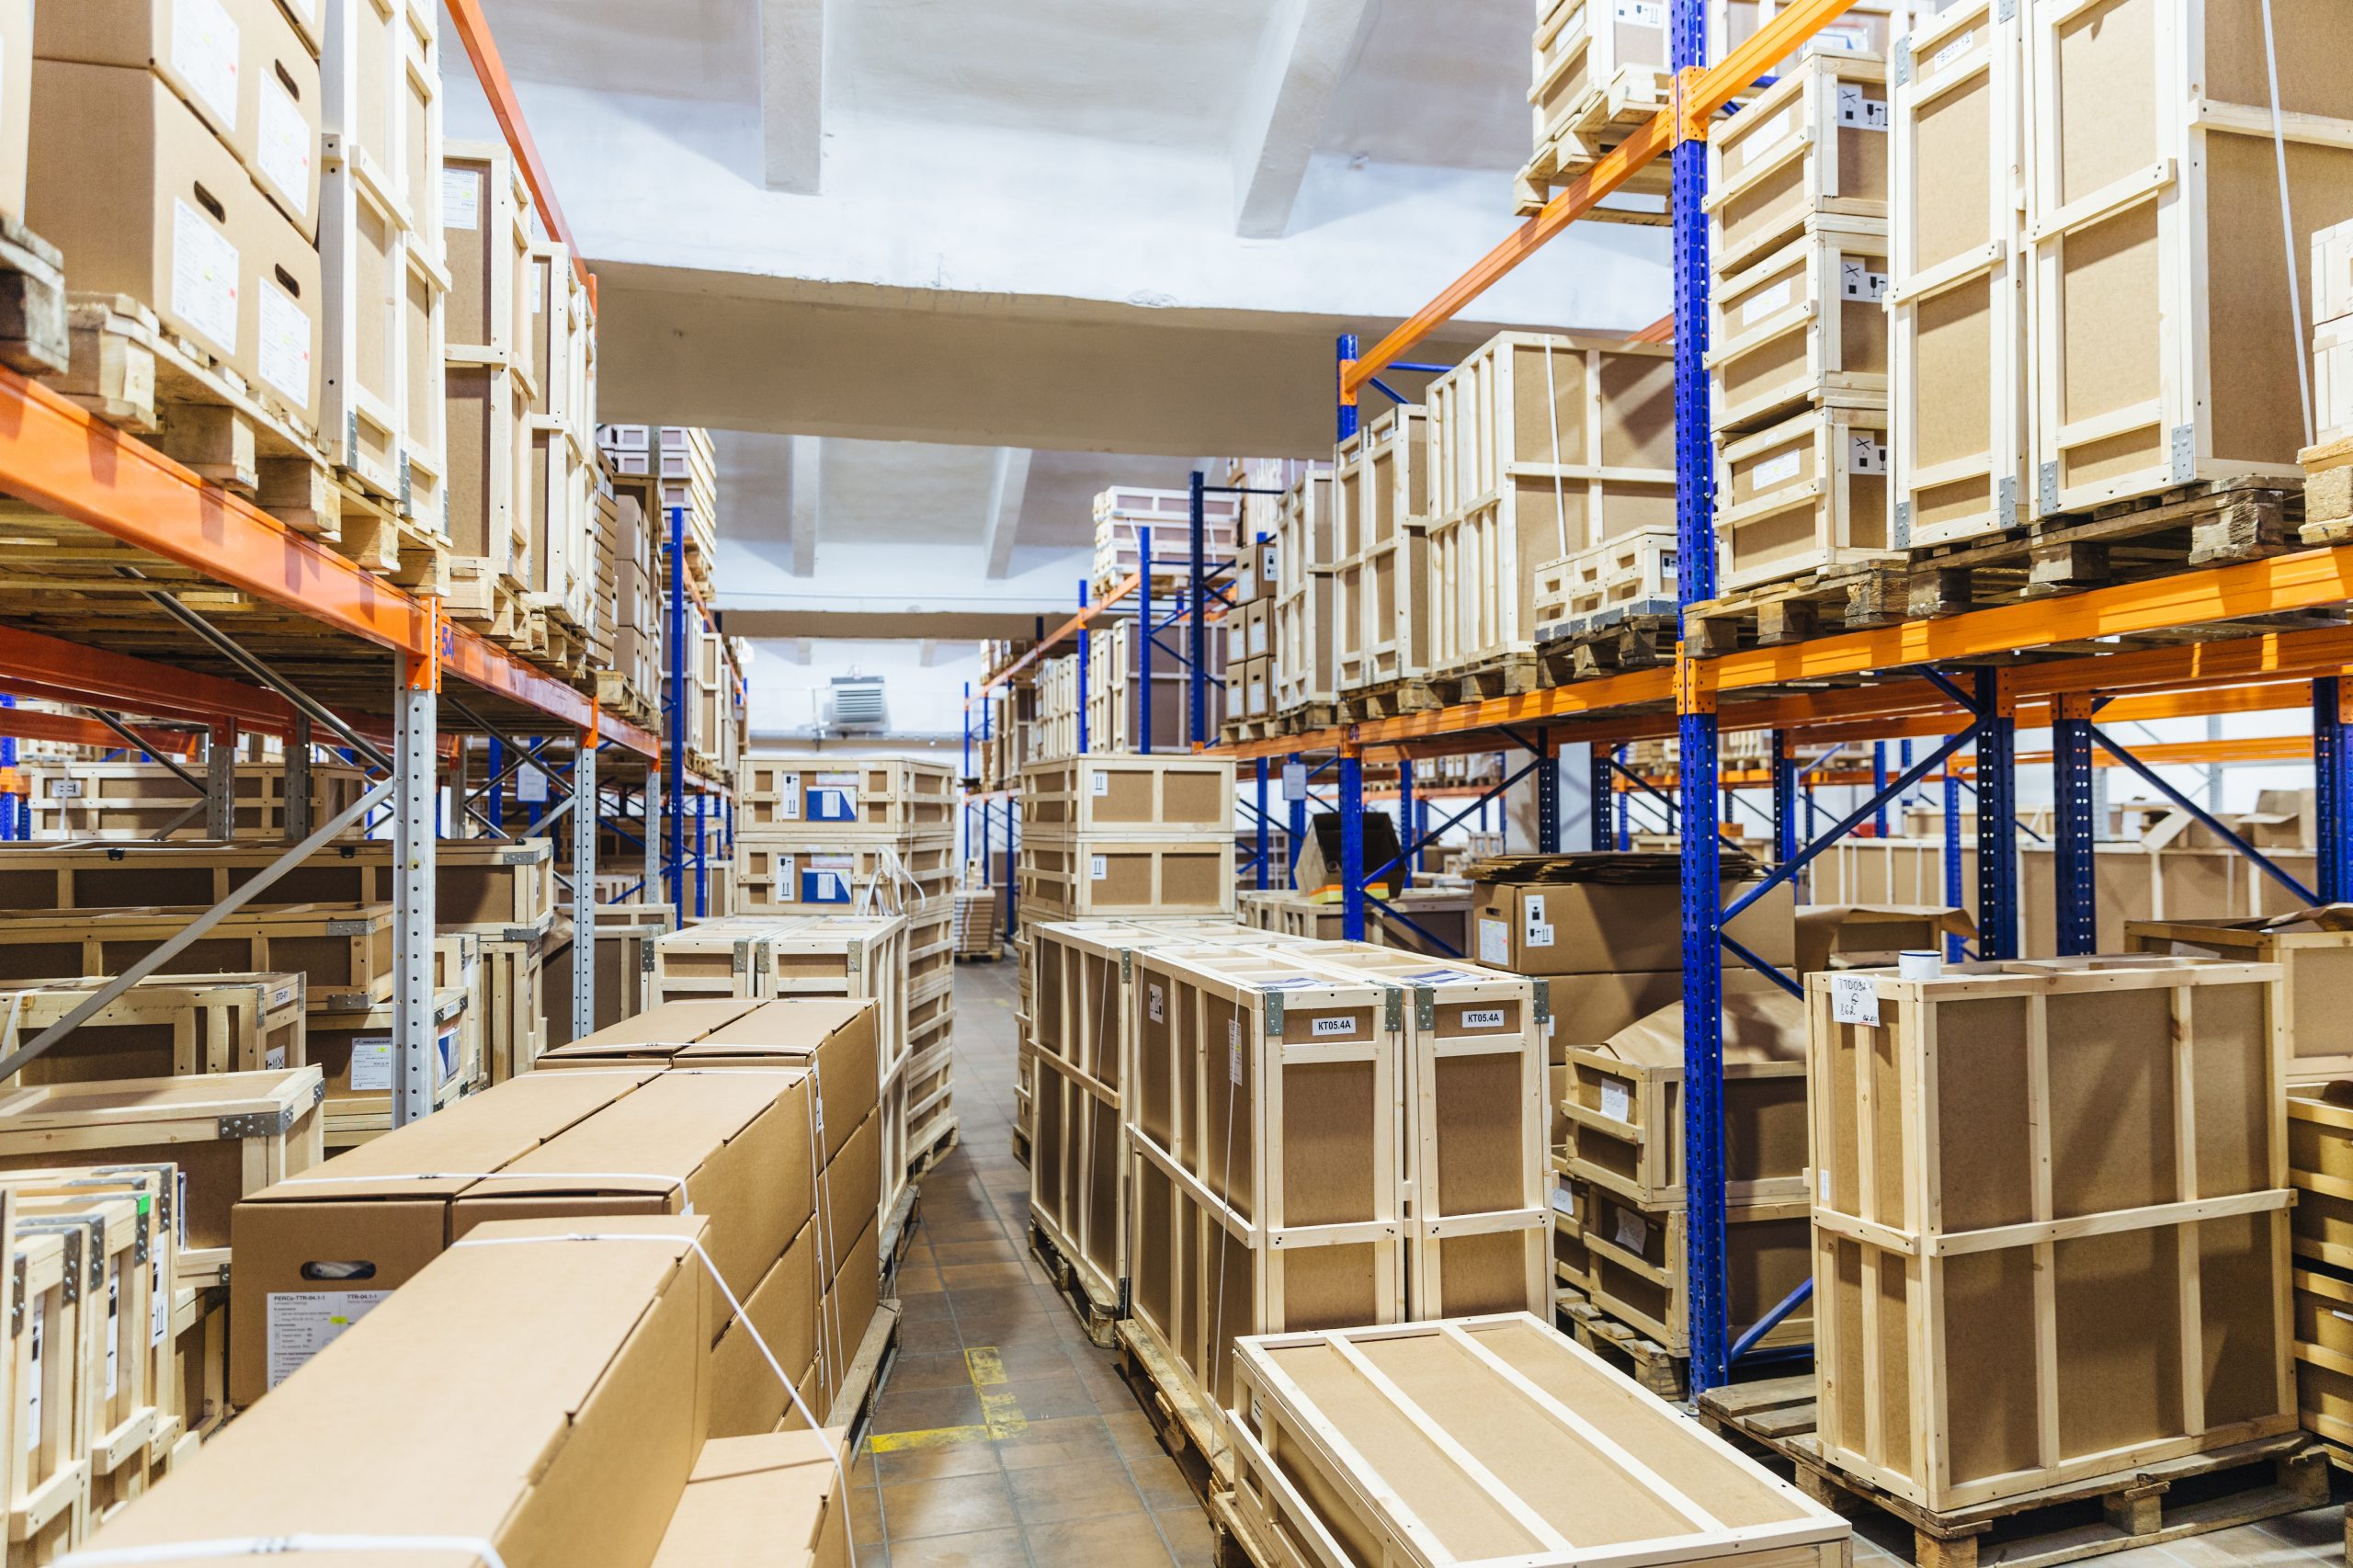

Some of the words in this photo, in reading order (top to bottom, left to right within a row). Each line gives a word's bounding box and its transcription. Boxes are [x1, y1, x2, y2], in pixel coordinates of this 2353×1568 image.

[441, 626, 454, 661] 54
[1467, 1013, 1499, 1023] KT05.4A
[1318, 1020, 1351, 1031] KT05.4A
